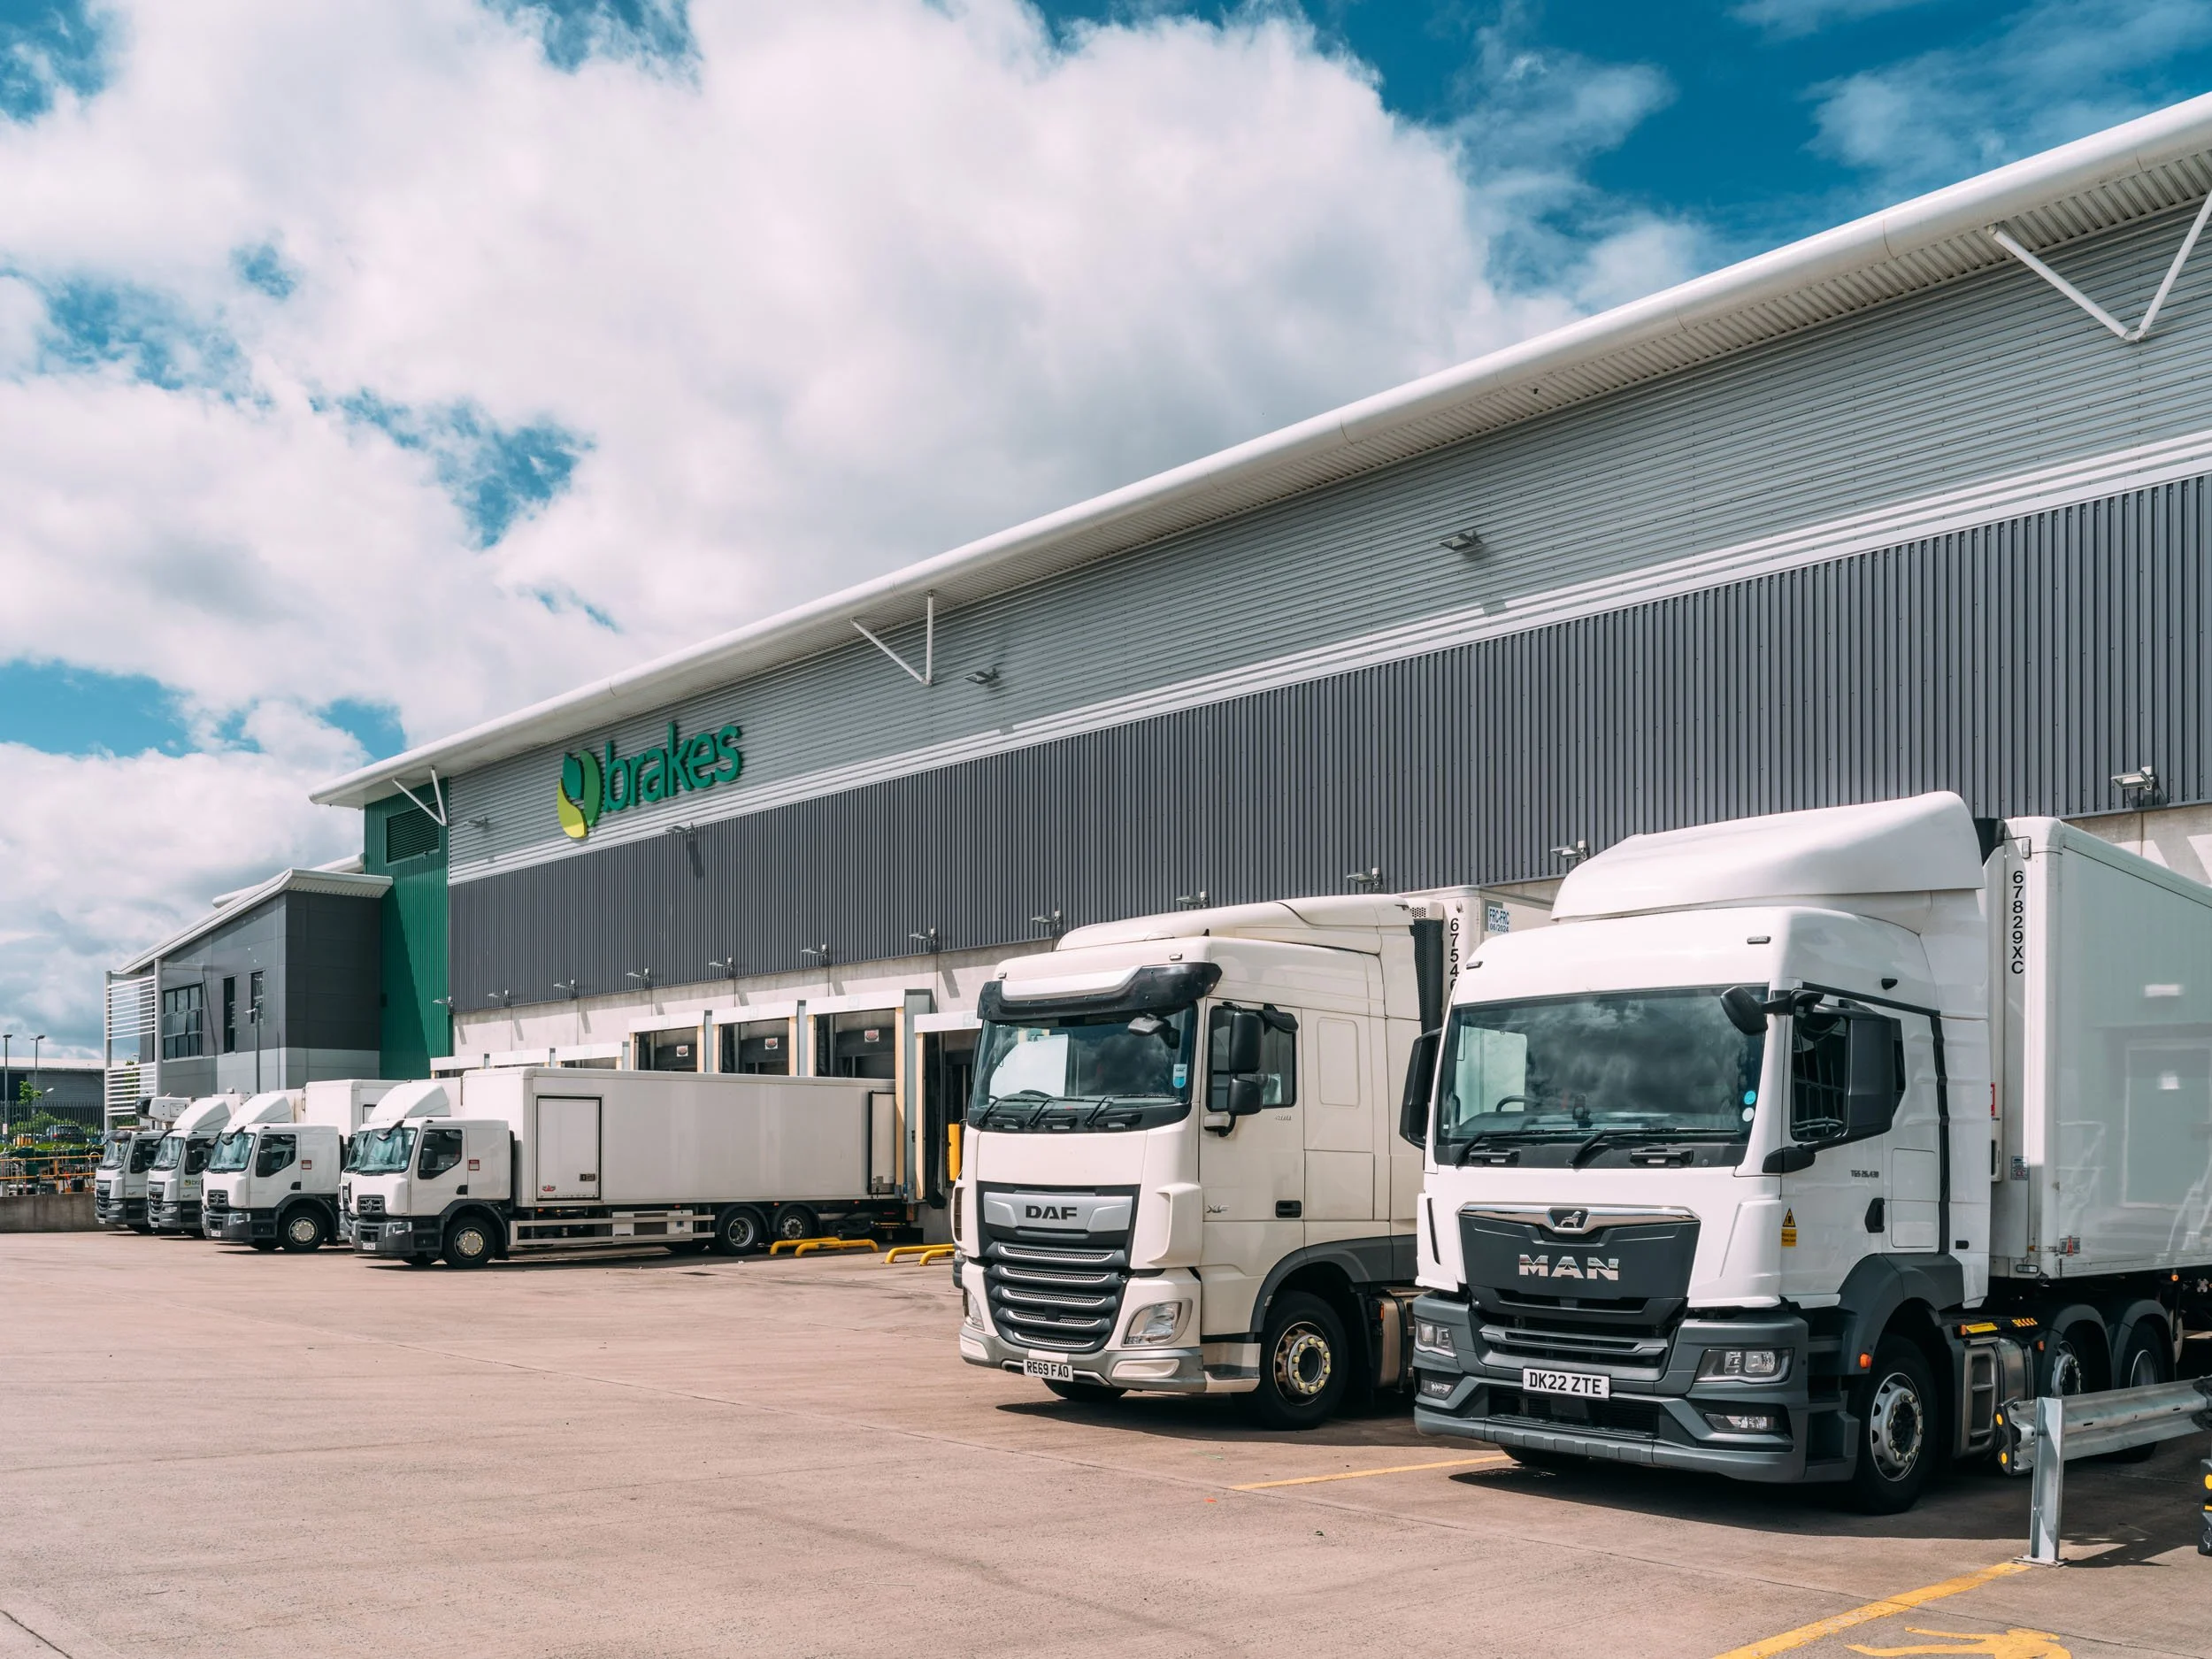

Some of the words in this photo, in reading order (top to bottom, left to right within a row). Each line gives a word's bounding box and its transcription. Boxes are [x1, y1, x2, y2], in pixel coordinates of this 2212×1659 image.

[603, 722, 742, 812] brakes
[2011, 870, 2024, 974] 67829XC
[1025, 1205, 1078, 1220] DAF
[1518, 1254, 1619, 1281] MAN
[1026, 1360, 1049, 1376] RE69
[1529, 1371, 1567, 1391] DK22
[1571, 1376, 1602, 1395] ZTE
